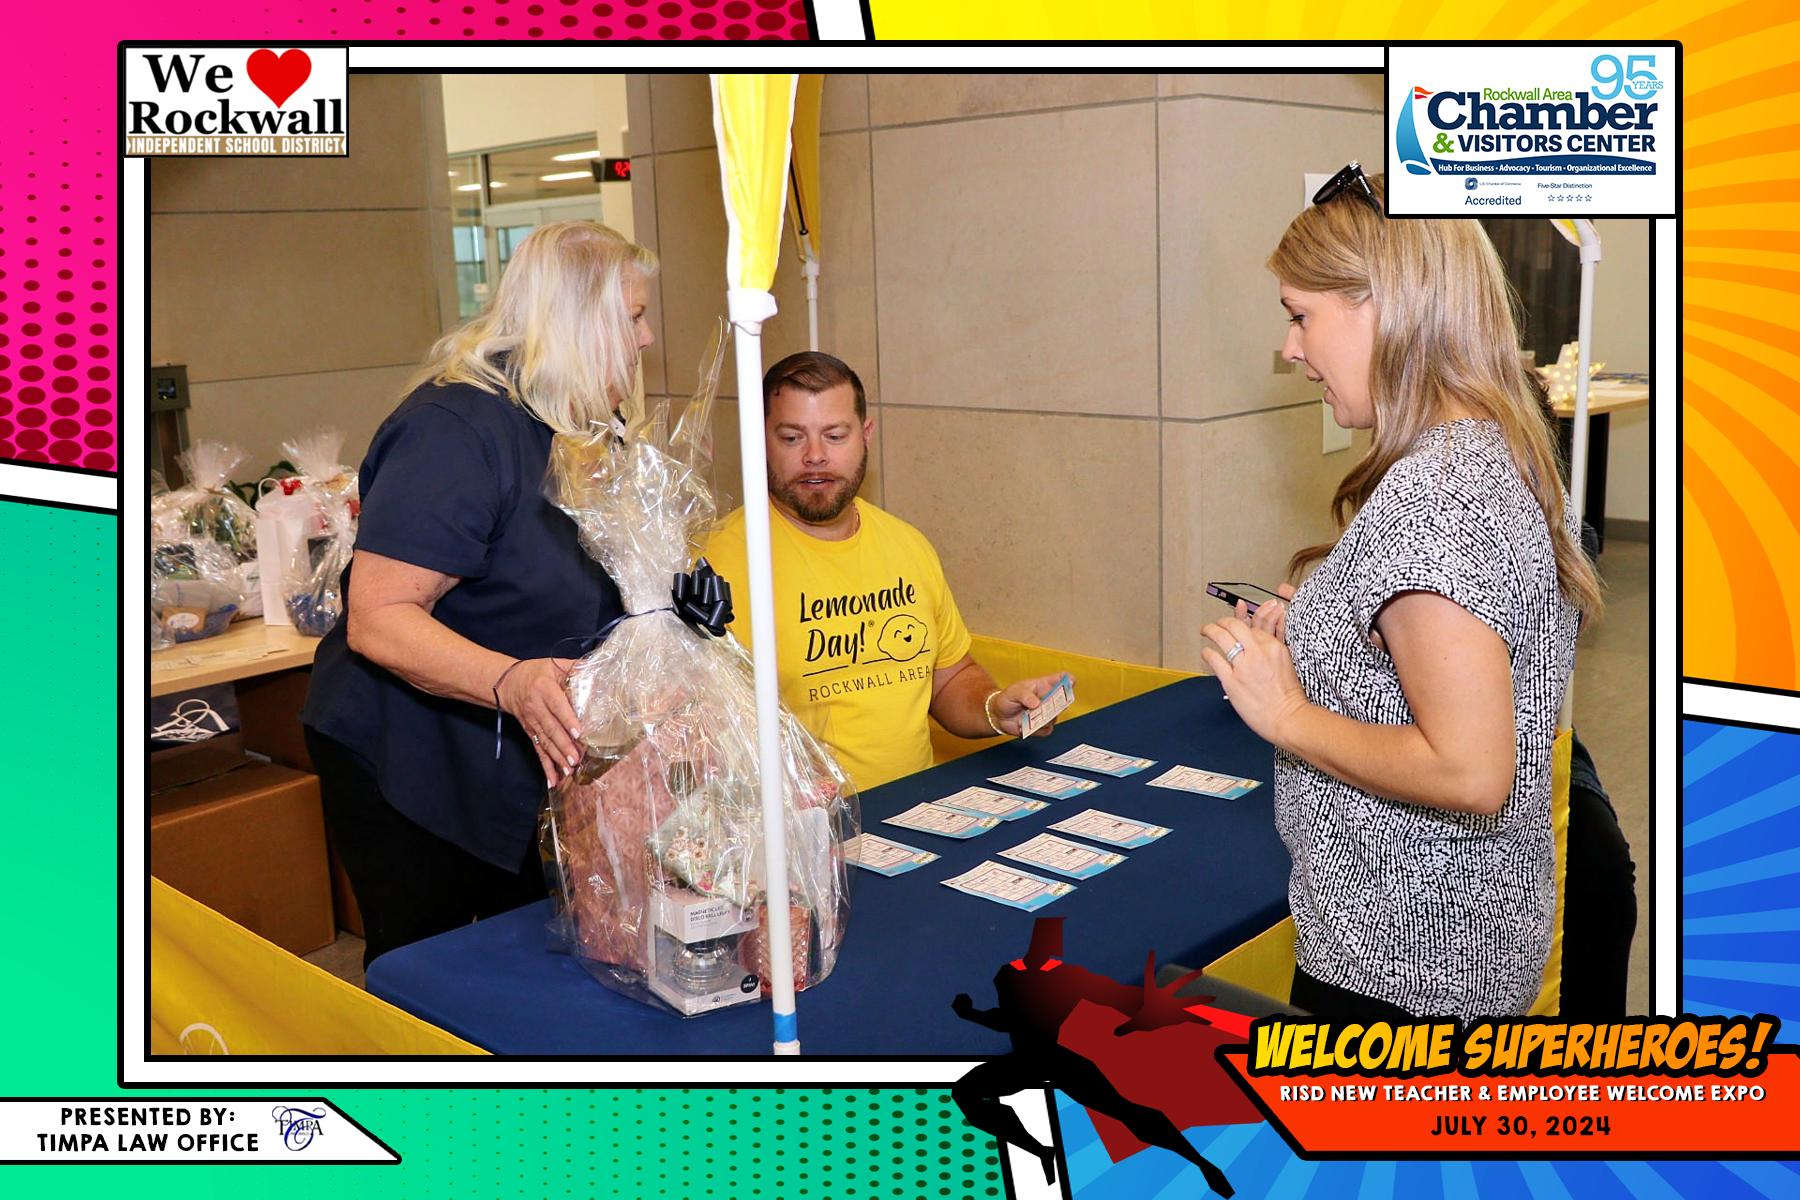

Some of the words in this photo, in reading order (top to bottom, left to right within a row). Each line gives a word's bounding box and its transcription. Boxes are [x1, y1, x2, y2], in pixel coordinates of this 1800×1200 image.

[800, 577, 917, 623] Lemonade
[808, 672, 893, 702] ROCKWALL
[899, 665, 931, 683] AREA
